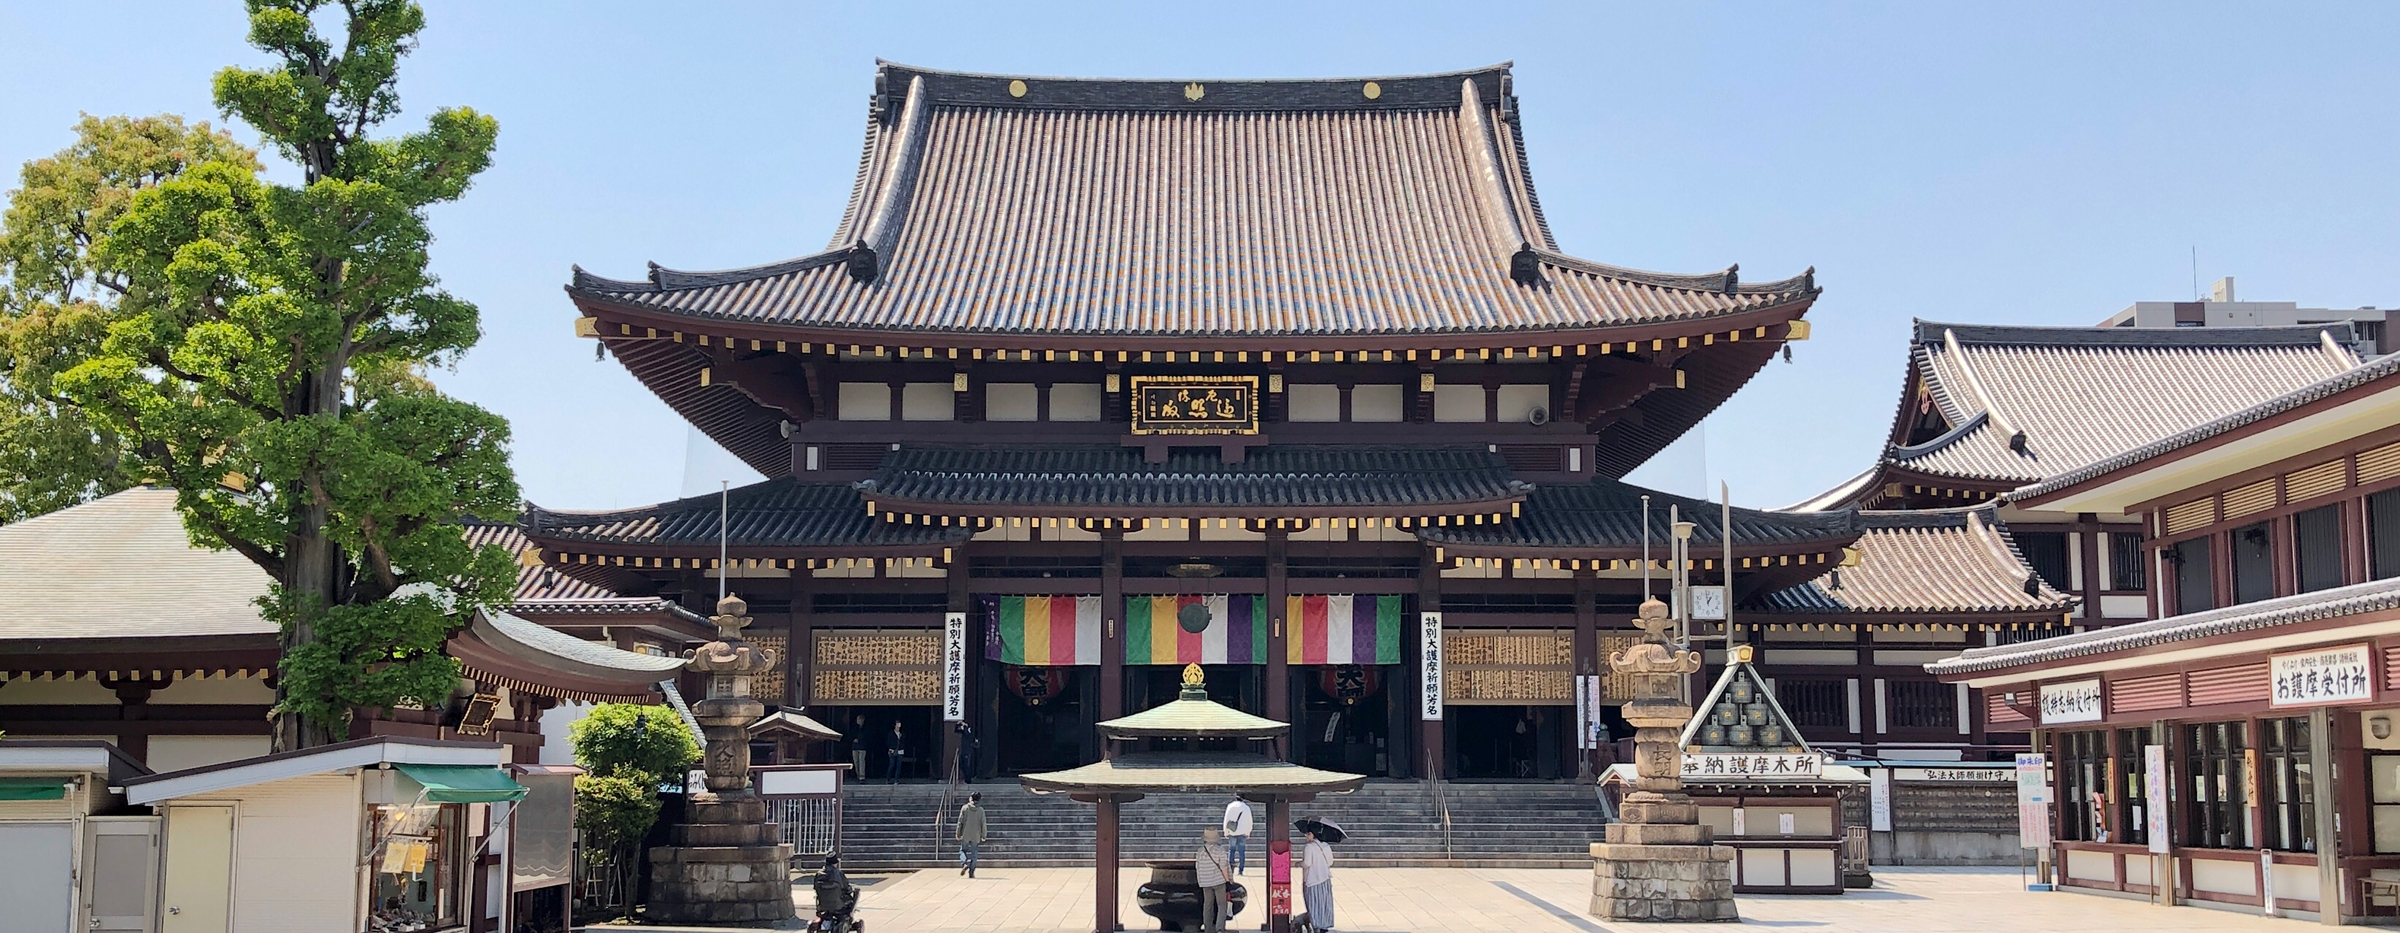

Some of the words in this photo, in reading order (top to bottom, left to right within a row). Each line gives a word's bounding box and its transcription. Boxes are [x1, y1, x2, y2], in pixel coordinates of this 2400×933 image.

[948, 617, 962, 716] 特別大護摩祈願芳名
[1425, 616, 1438, 715] 特別大護摩祈願芳名
[2277, 665, 2366, 699] お護摩受付所
